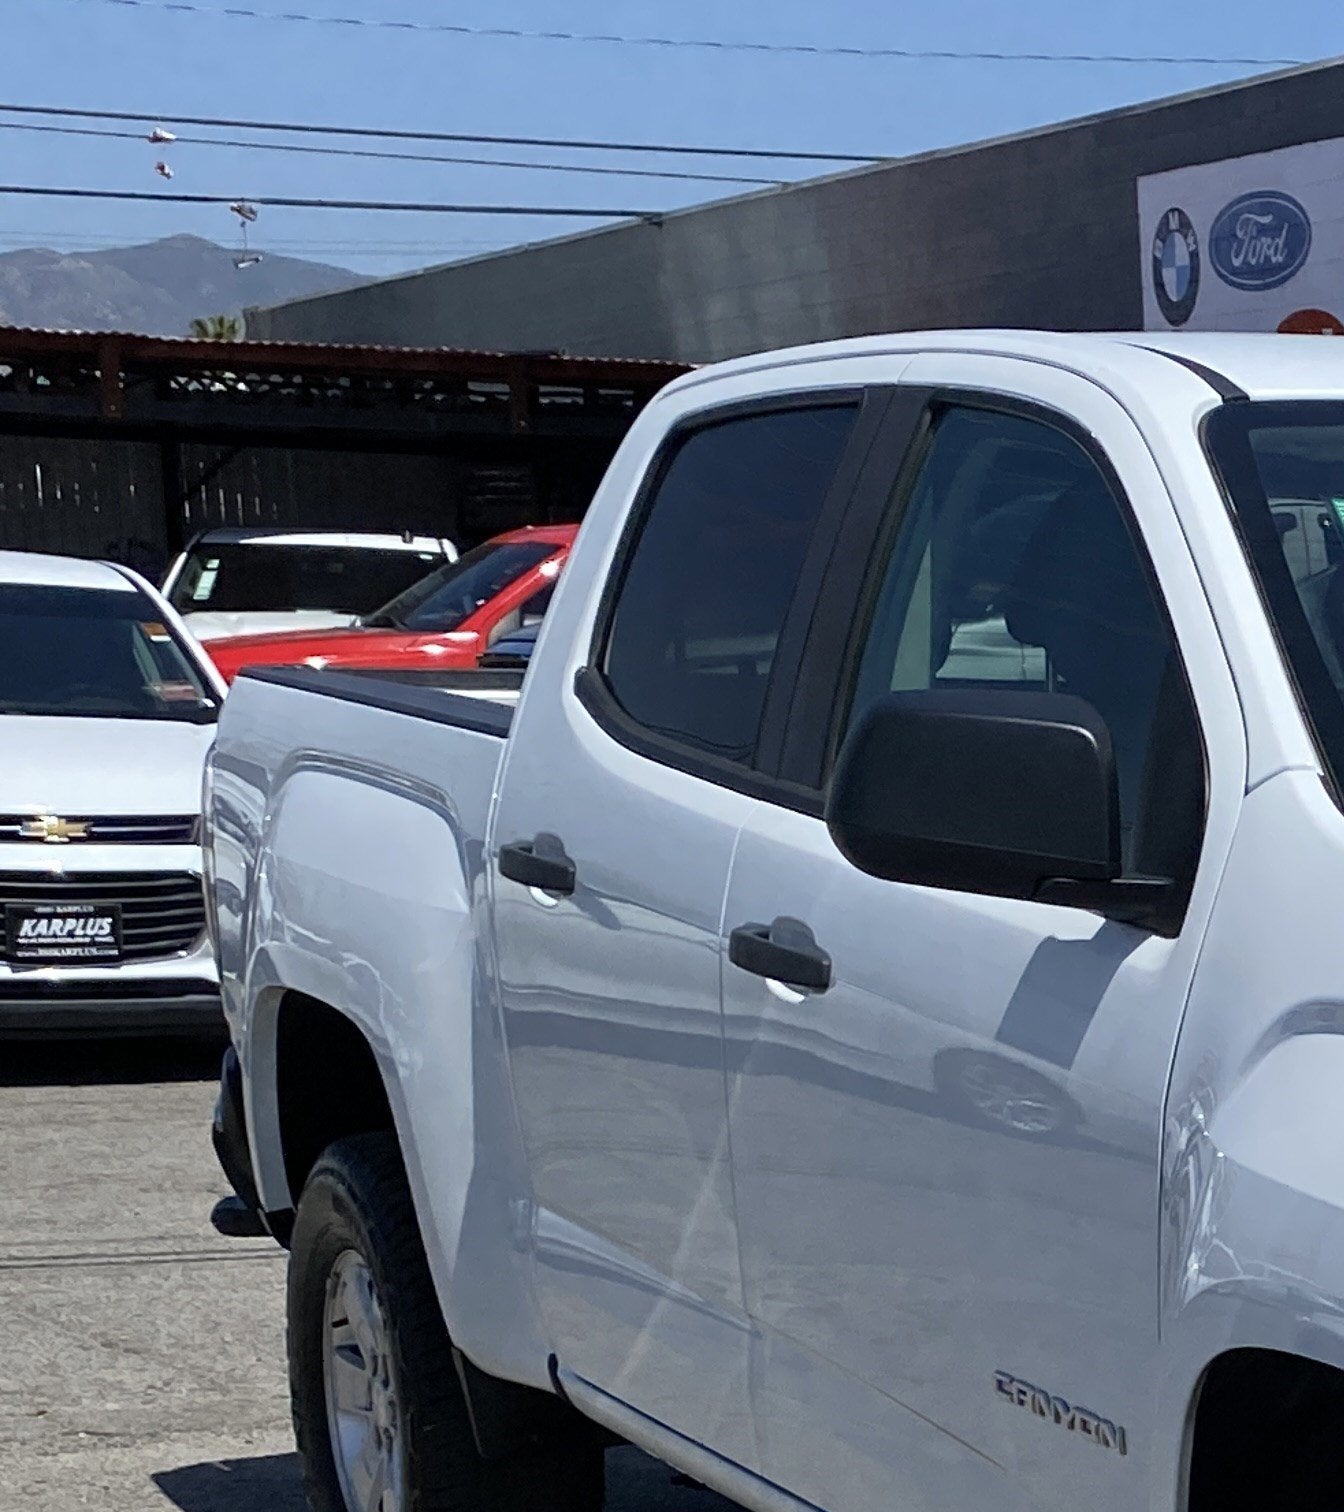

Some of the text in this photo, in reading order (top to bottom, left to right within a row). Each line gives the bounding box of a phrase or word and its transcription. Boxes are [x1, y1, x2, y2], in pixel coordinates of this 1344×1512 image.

[1231, 212, 1289, 267] Ford
[19, 917, 113, 937] KARPLUS
[993, 1368, 1128, 1456] CANYON
